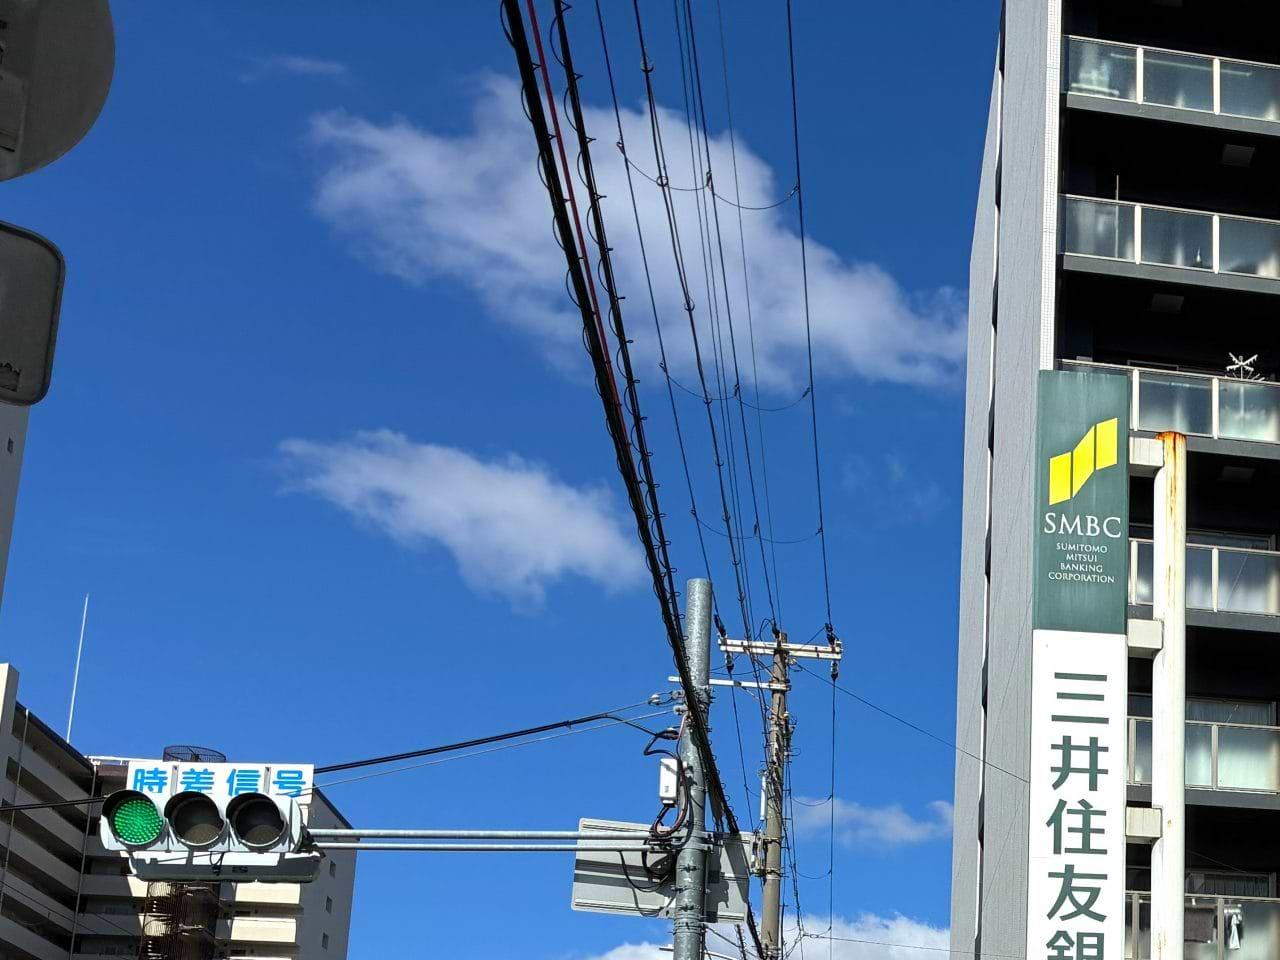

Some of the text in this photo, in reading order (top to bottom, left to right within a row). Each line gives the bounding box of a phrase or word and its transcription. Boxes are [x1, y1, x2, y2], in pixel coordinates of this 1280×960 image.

[1044, 513, 1121, 538] SMBC
[1056, 542, 1108, 553] SUMITOMO
[1066, 553, 1098, 562] MITSUI
[1060, 562, 1103, 573] BANKING
[1048, 571, 1115, 584] CORPORATION
[132, 767, 307, 798] 時差信号
